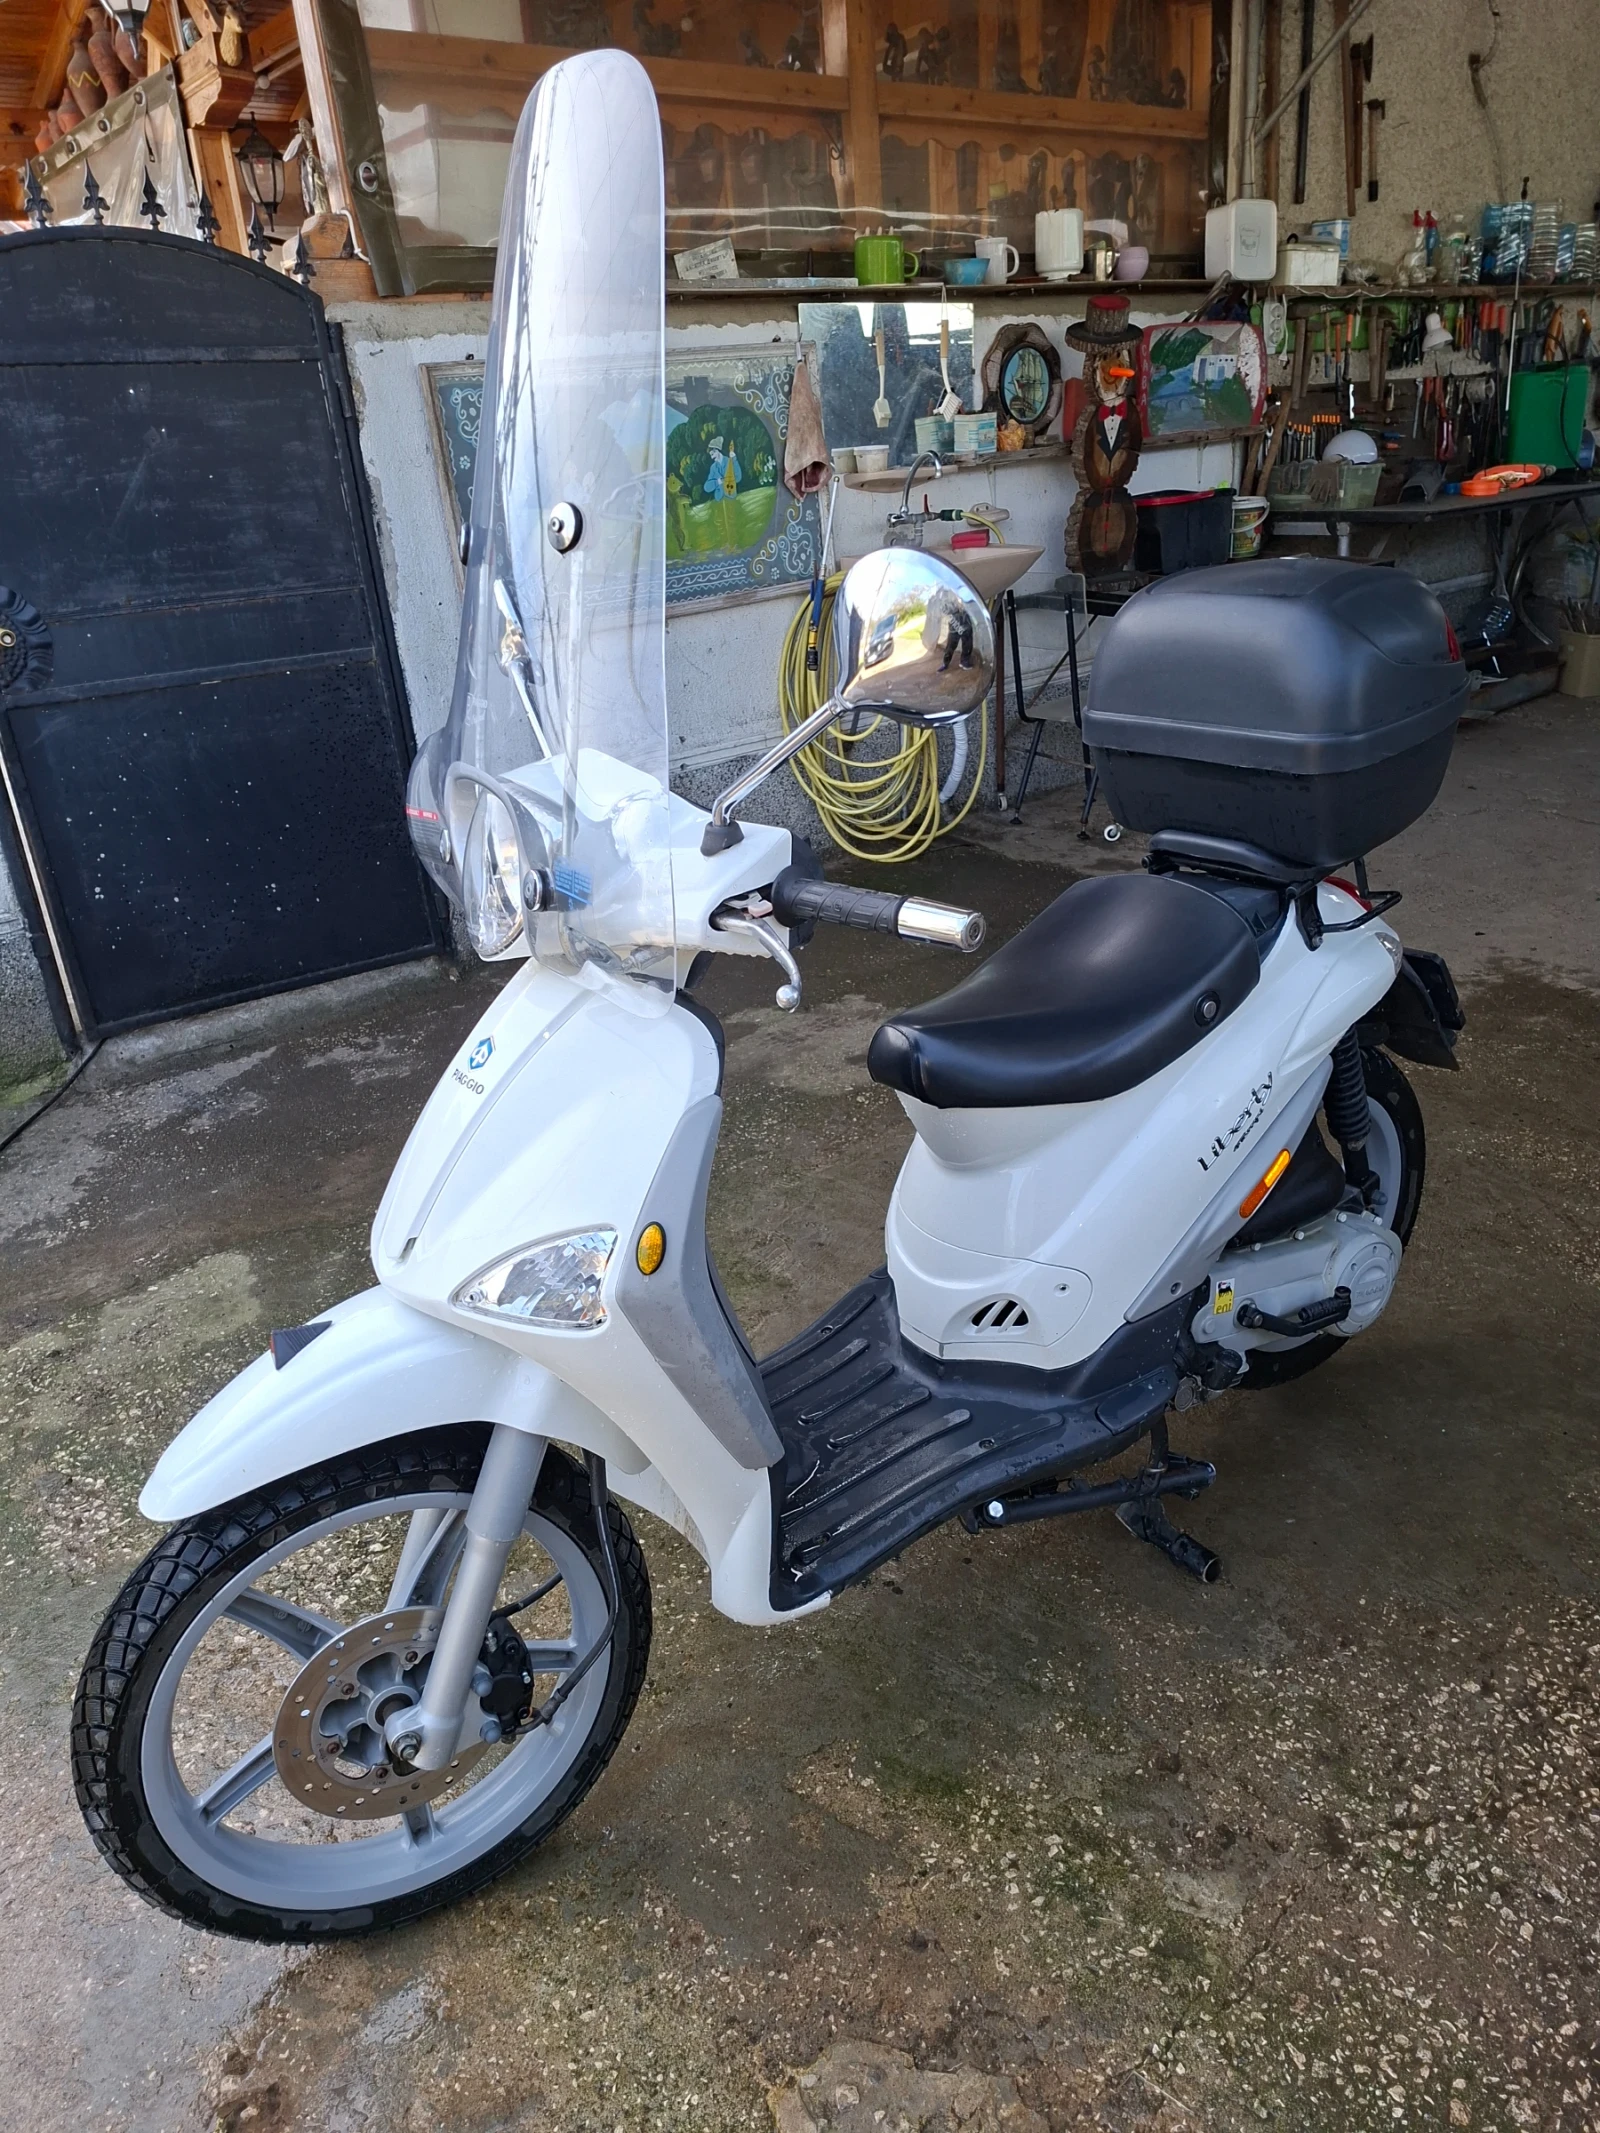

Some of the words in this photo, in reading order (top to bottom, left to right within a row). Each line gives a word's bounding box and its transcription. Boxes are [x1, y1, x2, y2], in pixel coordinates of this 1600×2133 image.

[451, 1068, 485, 1095] PIAGGIO
[1197, 1071, 1272, 1171] Liberty
[1215, 1298, 1232, 1314] eni
